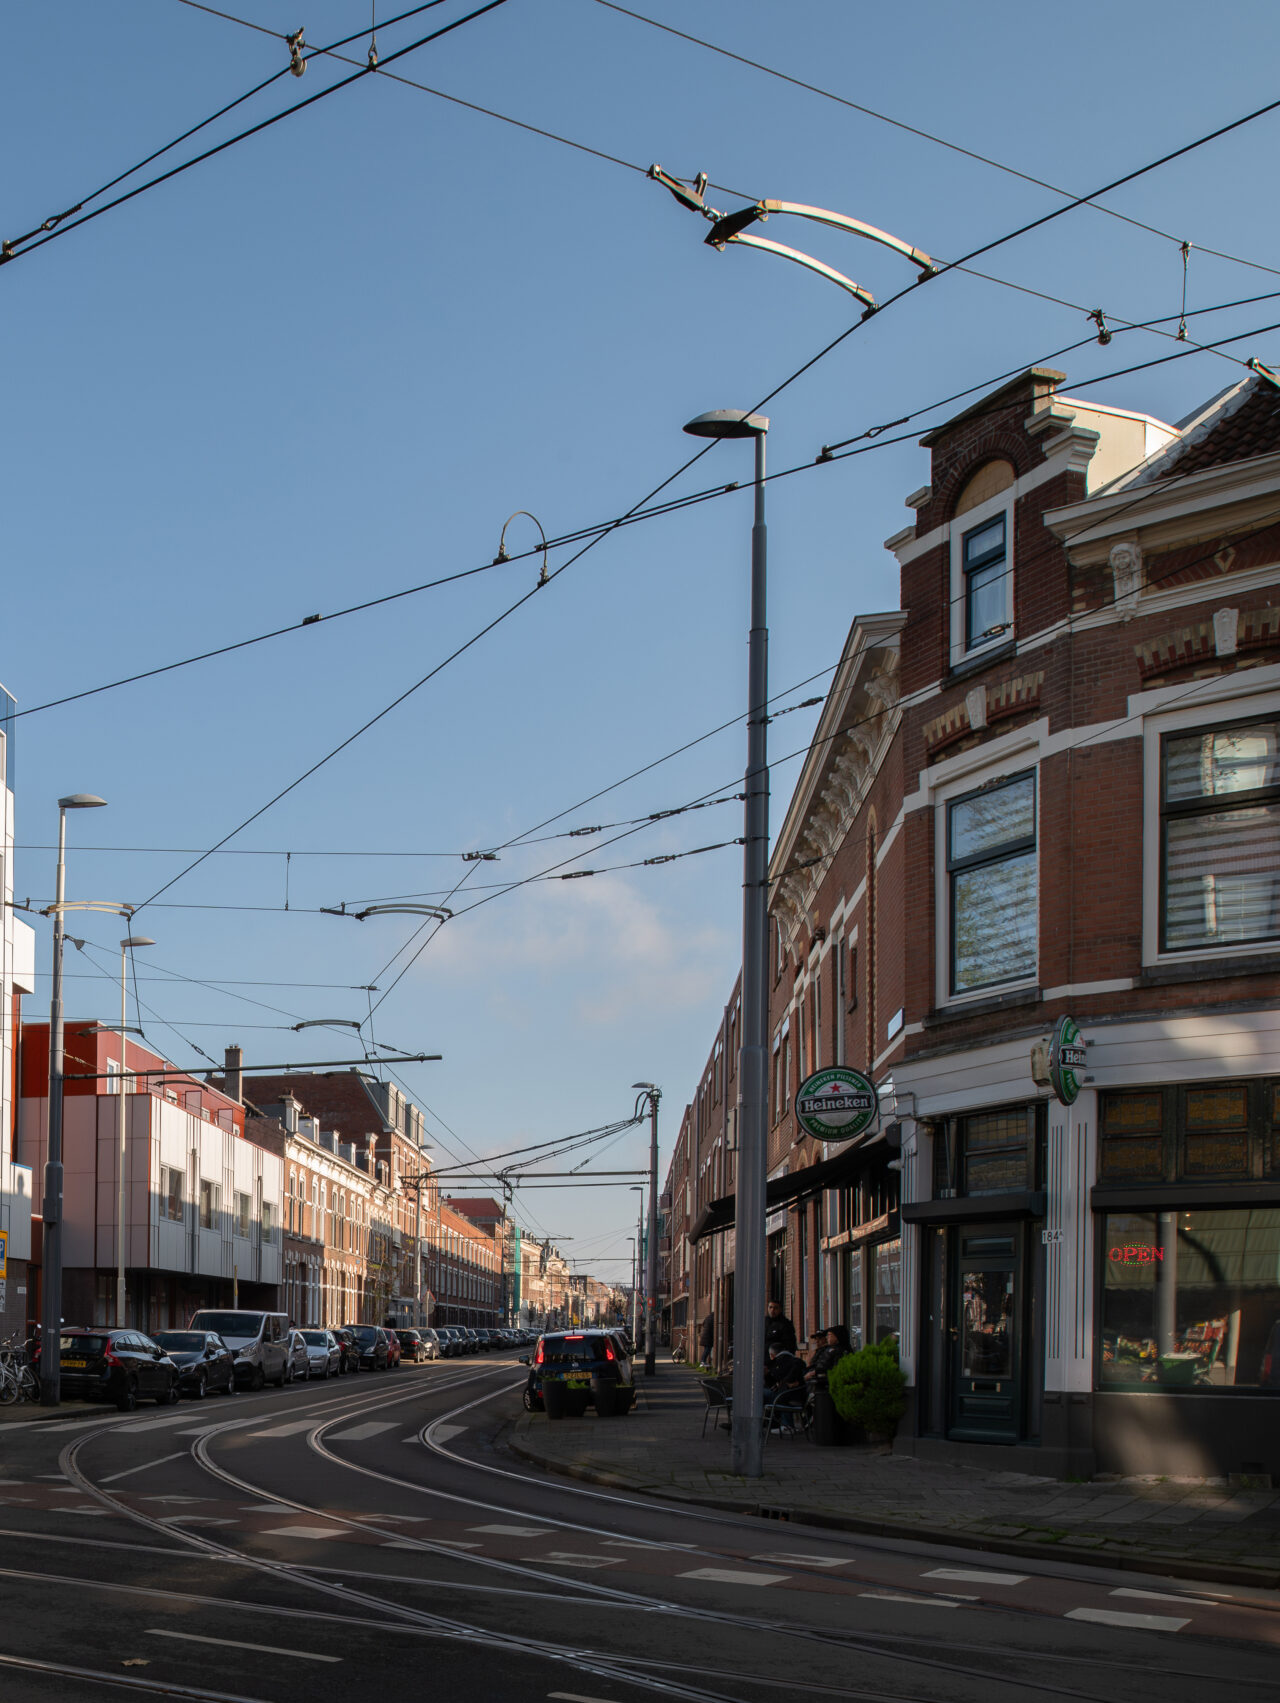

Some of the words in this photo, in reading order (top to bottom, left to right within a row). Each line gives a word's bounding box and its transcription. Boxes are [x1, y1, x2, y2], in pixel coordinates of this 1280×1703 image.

[808, 1073, 835, 1093] HEINEKEN
[804, 1095, 869, 1112] Heineken
[809, 1119, 838, 1135] PREMIUM
[840, 1115, 865, 1134] QUALITY
[1108, 1246, 1165, 1262] OPEN
